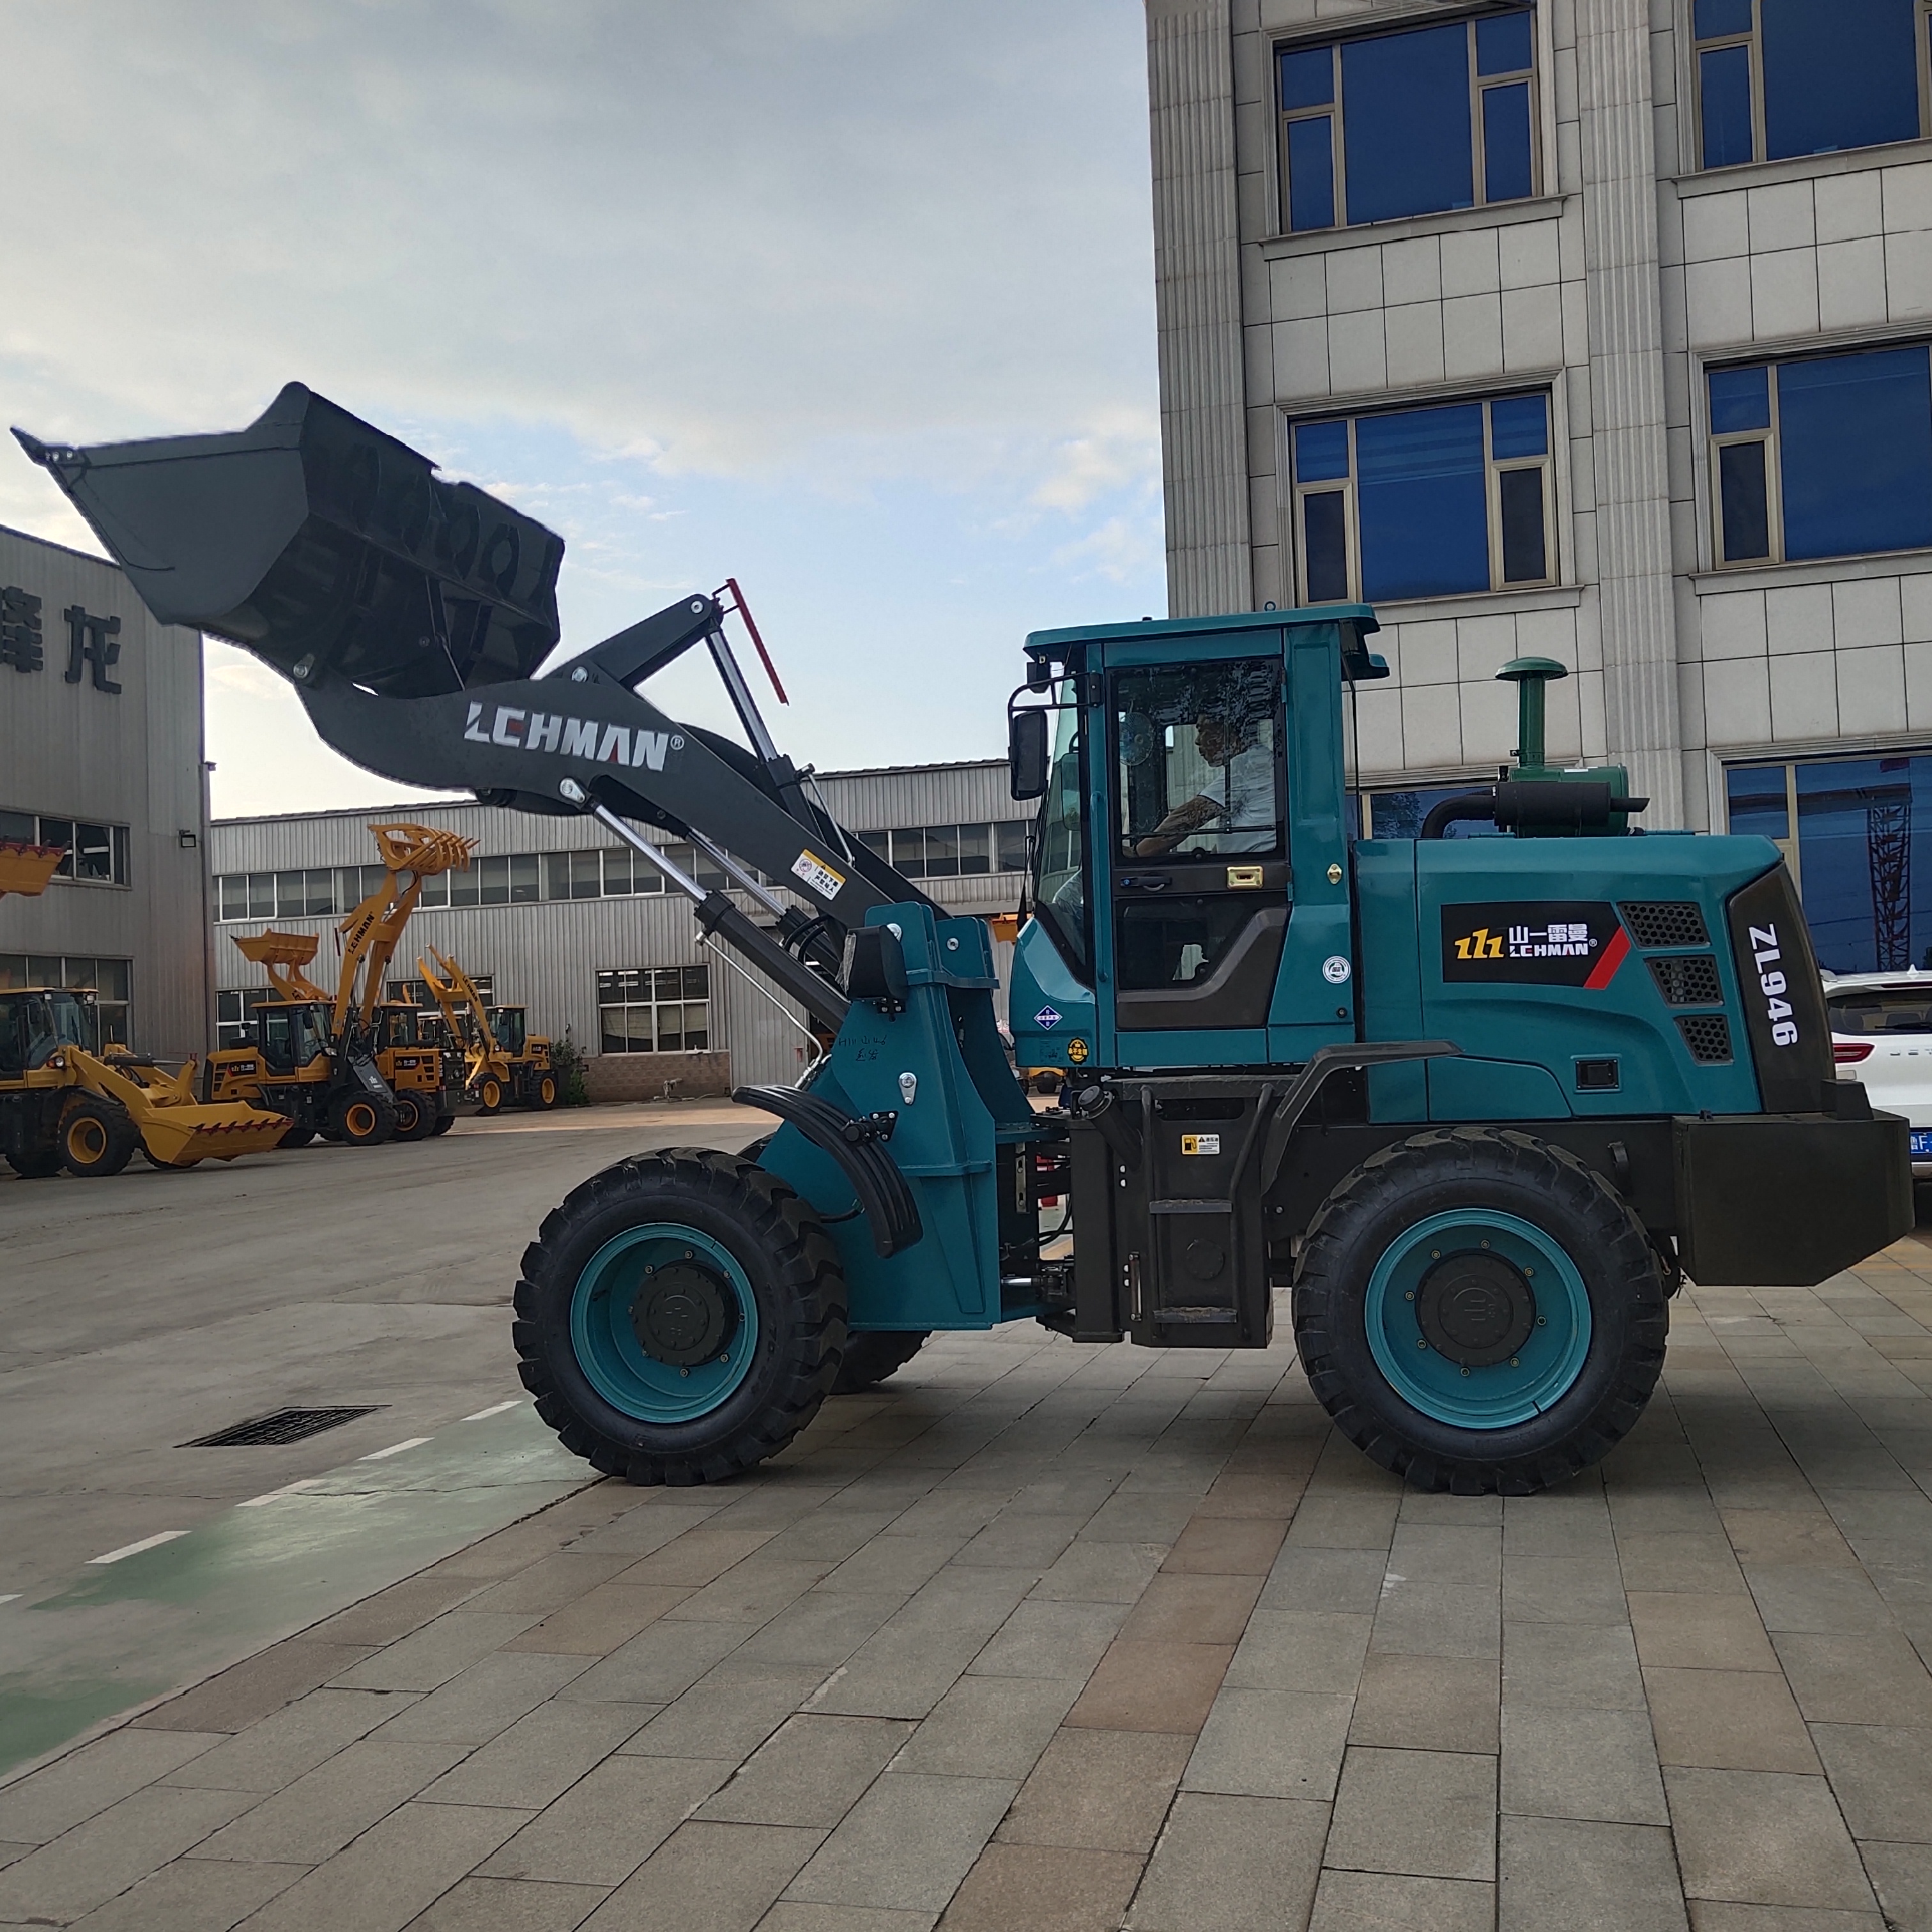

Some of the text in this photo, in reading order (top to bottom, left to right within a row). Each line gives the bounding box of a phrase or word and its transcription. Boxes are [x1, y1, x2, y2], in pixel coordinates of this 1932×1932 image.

[1508, 923, 1588, 944] 山一雷曼
[1749, 923, 1798, 1046] ZL946
